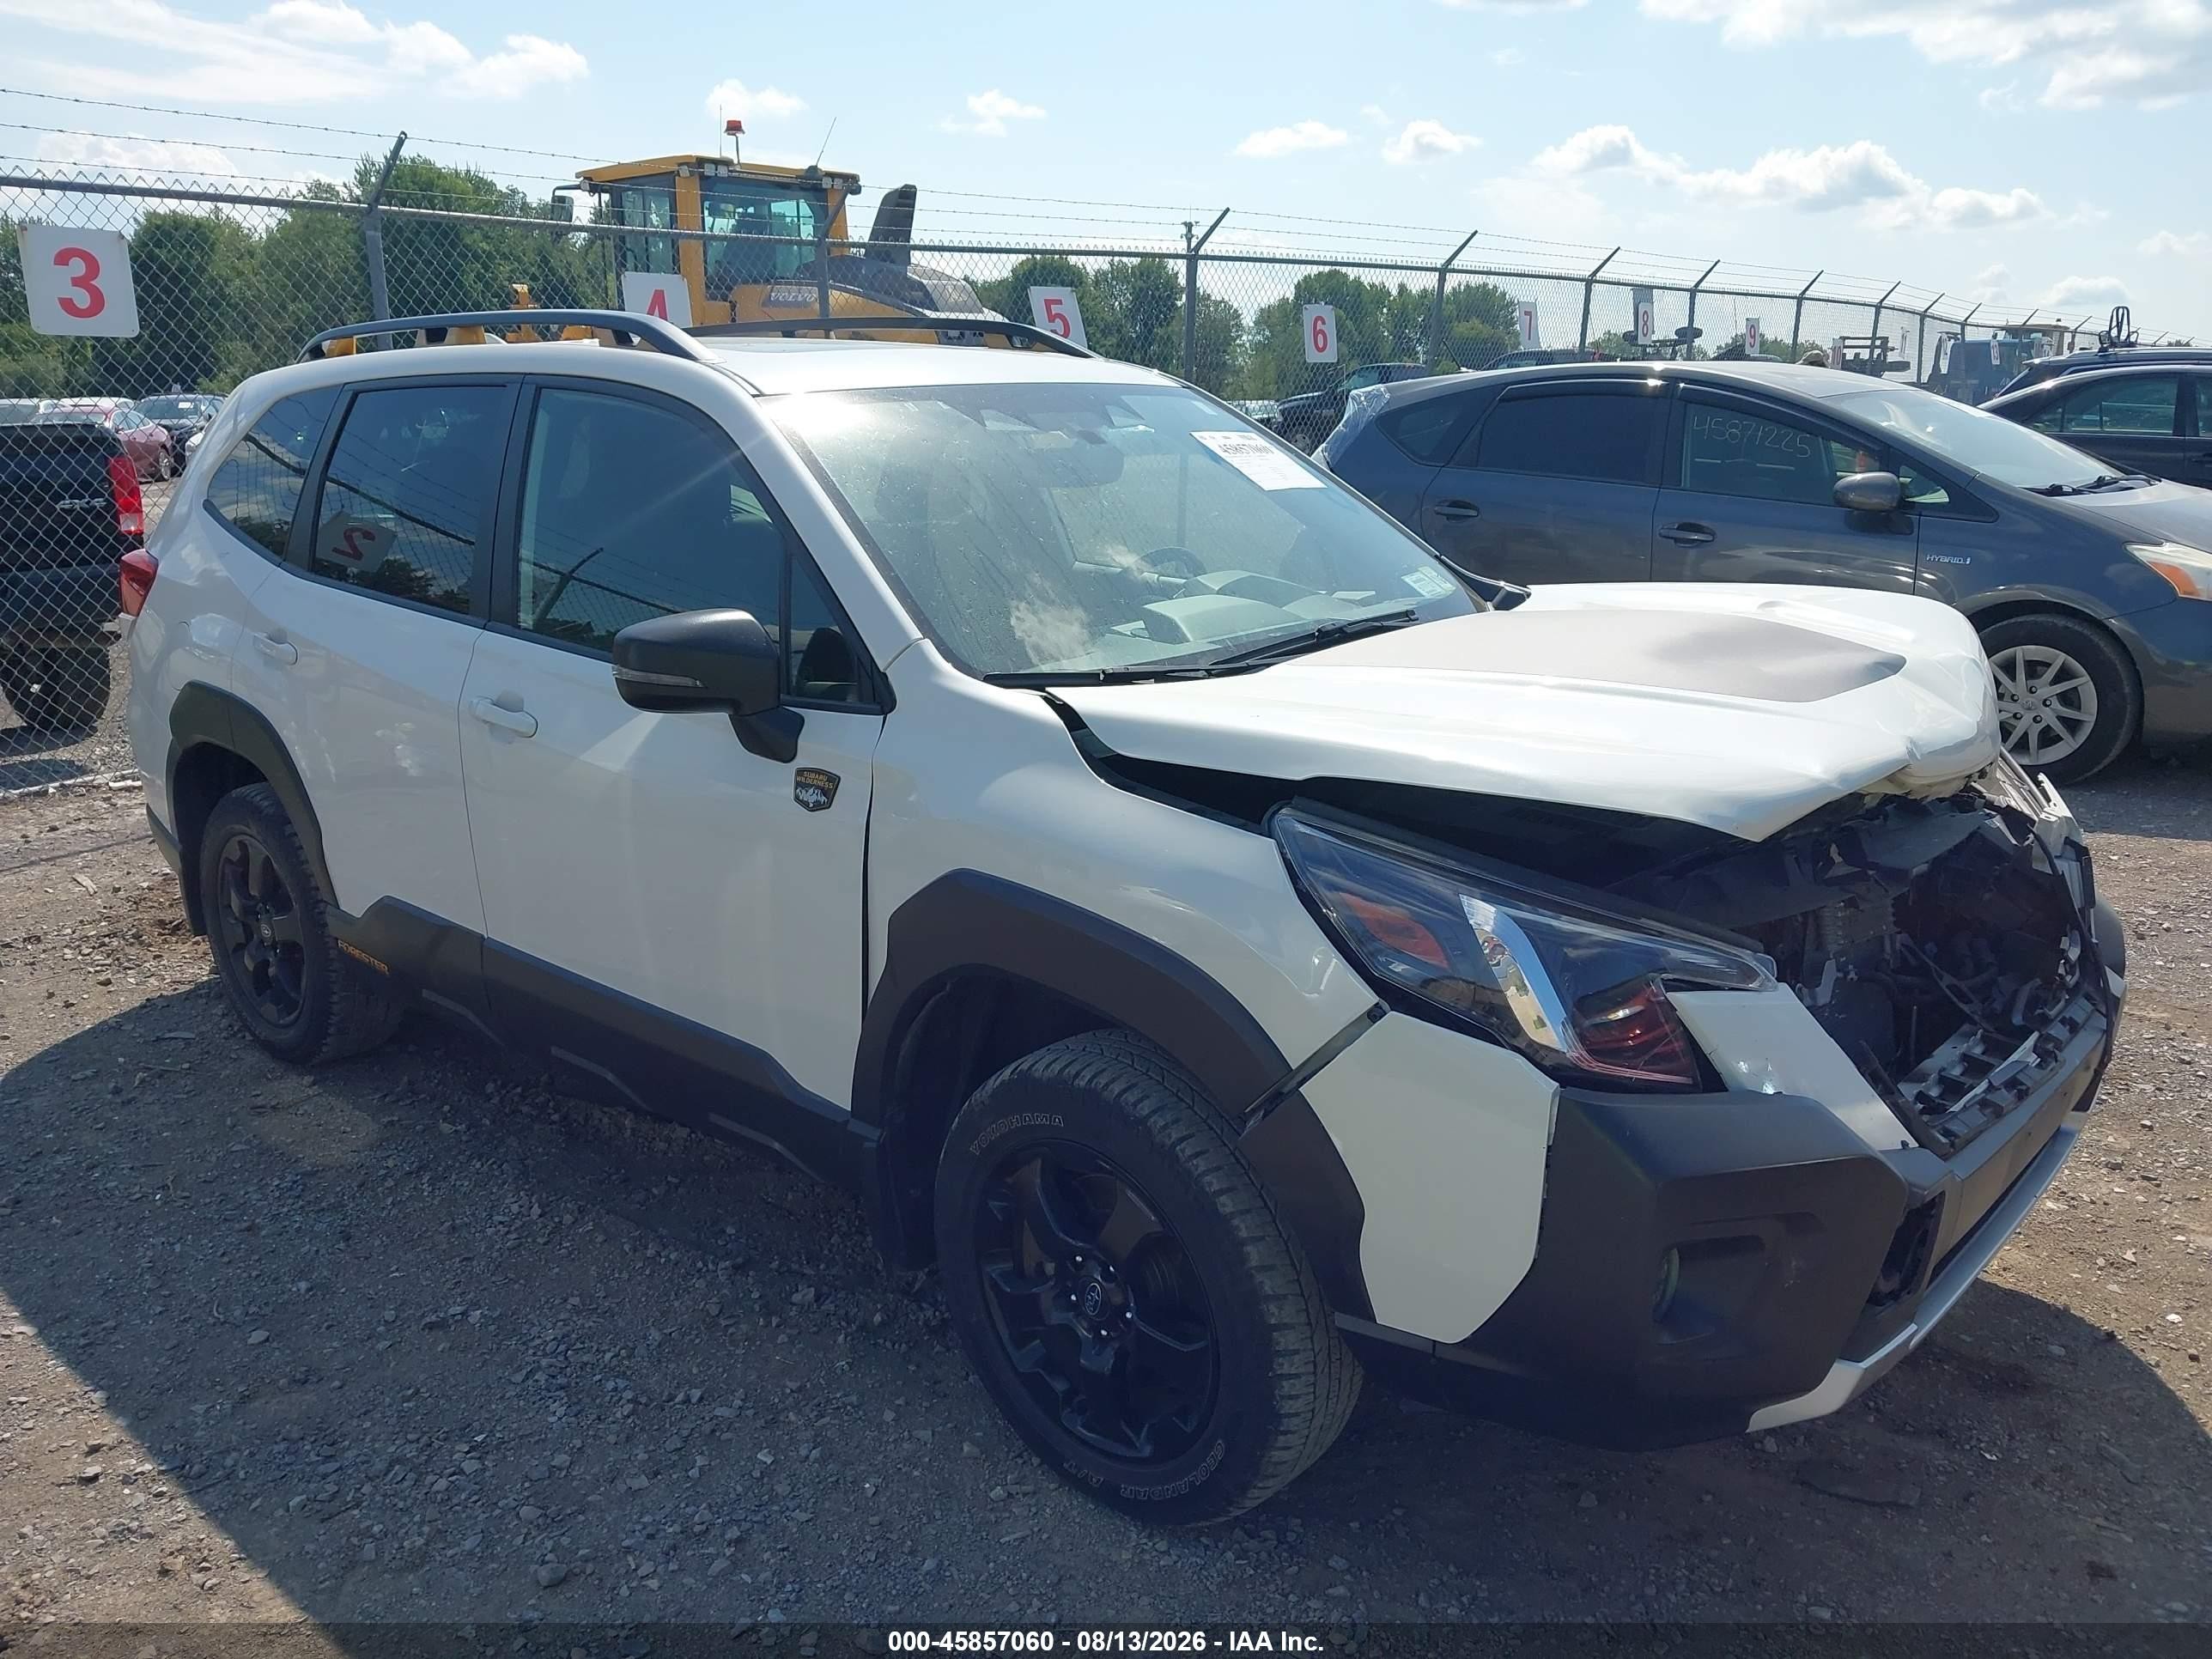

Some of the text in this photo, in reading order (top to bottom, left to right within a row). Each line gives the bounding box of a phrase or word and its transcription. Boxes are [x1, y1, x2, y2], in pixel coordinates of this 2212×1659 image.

[53, 246, 106, 319] 3
[770, 293, 816, 302] VOLVO
[1043, 298, 1071, 338] 5
[1312, 315, 1329, 354] 6
[1524, 311, 1533, 341] 7
[1642, 310, 1650, 337] 8
[1748, 325, 1756, 349] 9
[1991, 343, 1999, 361] 13
[1693, 416, 1810, 458] 45871225
[796, 775, 834, 789] WILDERNESS
[803, 771, 828, 781] SUBARU
[337, 939, 390, 975] FORESTER
[969, 1113, 1064, 1156] YOKOHAMA
[1120, 1439, 1225, 1500] GEOLANDAR
